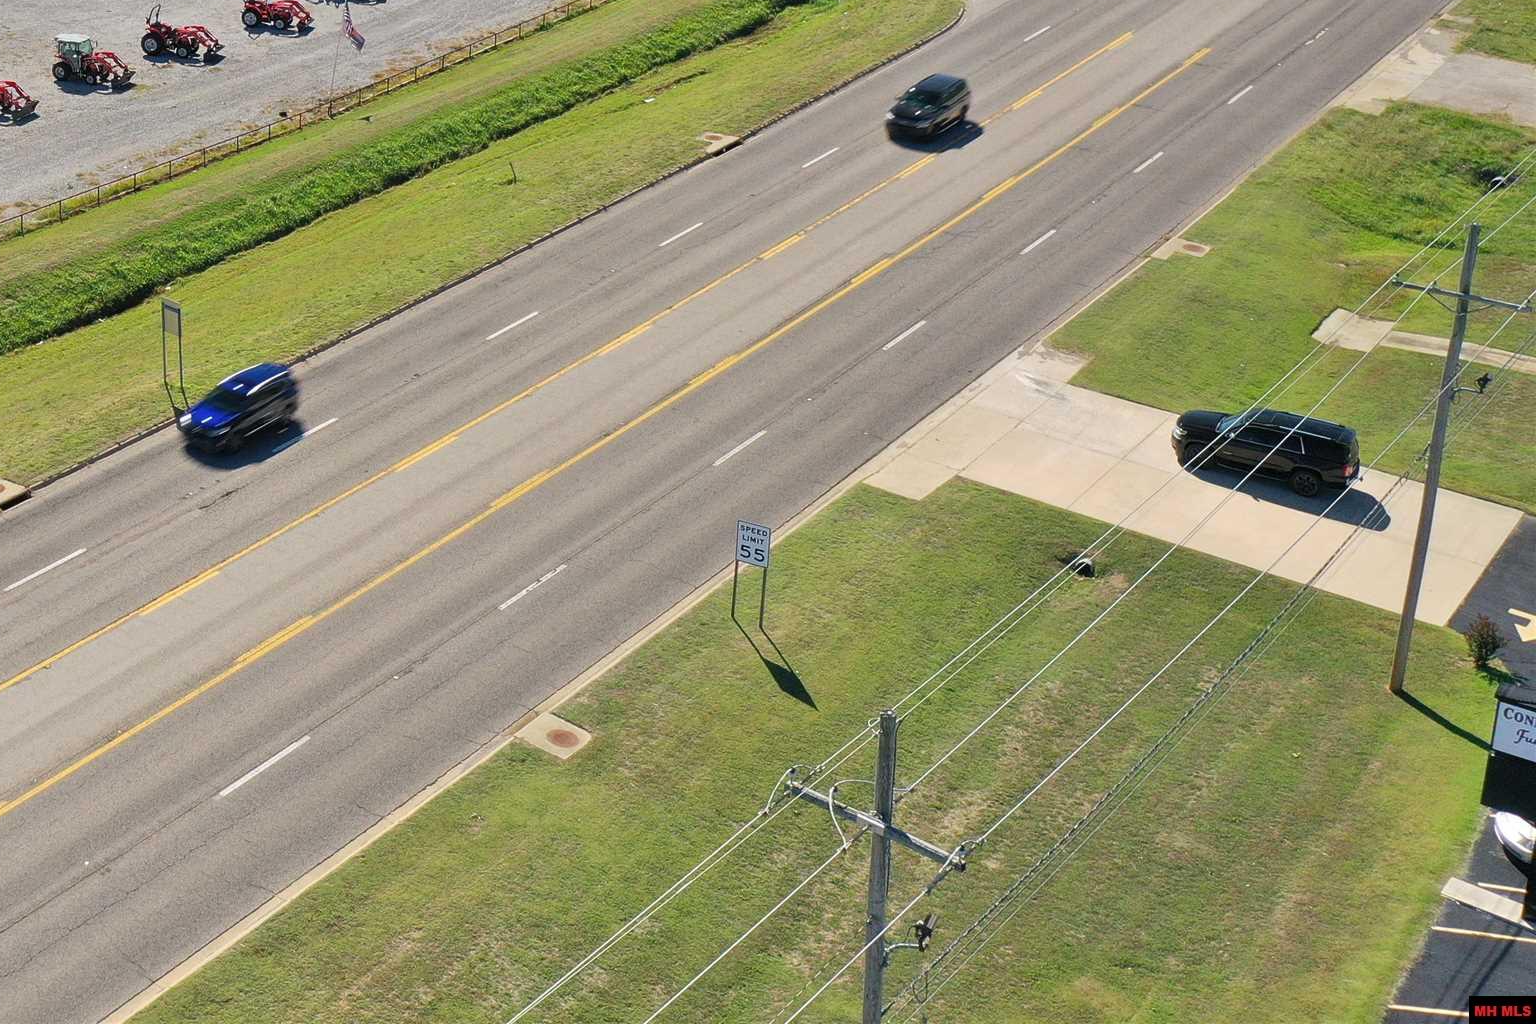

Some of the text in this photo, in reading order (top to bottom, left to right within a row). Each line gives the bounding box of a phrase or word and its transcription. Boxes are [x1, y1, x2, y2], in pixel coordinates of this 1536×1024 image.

[740, 525, 768, 537] SPEED
[742, 534, 765, 545] LIMIT
[740, 544, 765, 563] 55
